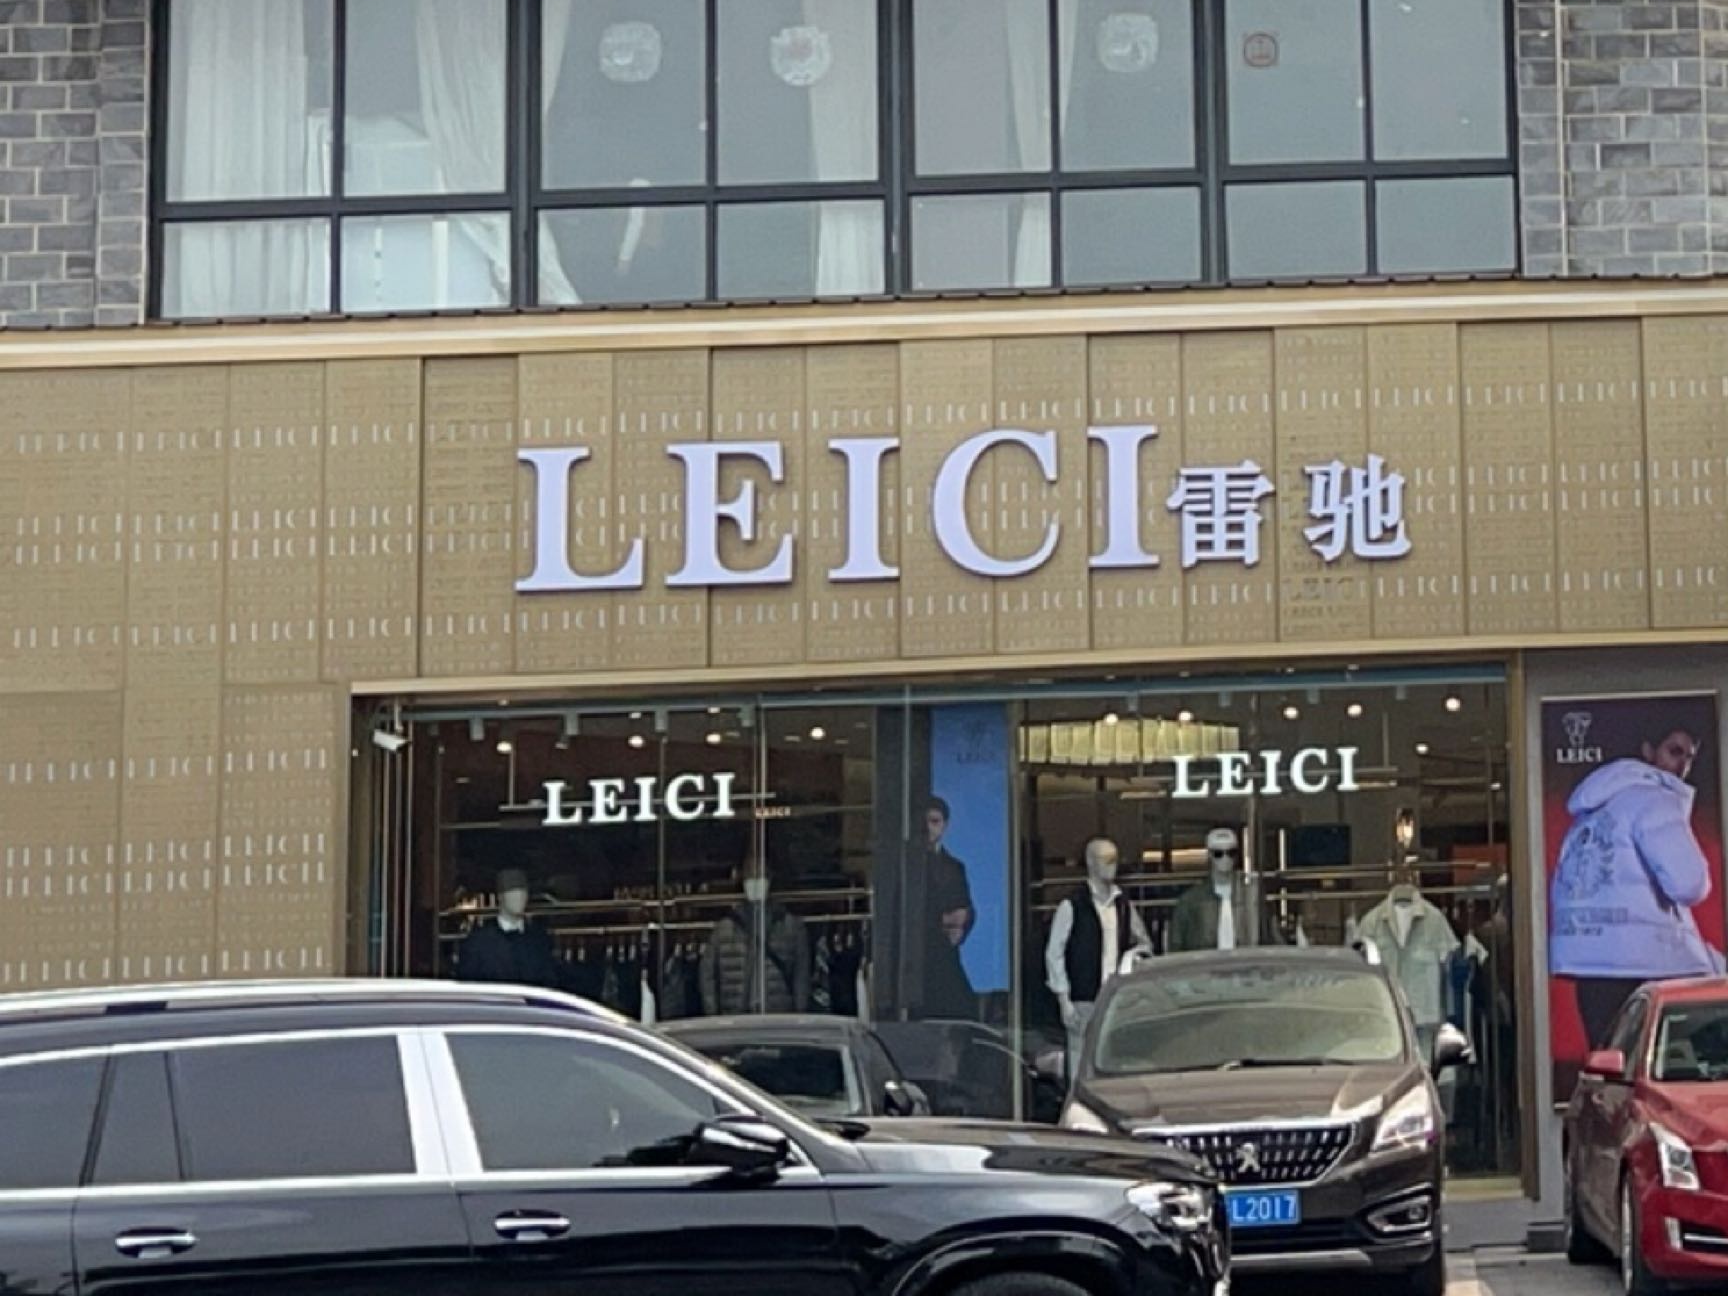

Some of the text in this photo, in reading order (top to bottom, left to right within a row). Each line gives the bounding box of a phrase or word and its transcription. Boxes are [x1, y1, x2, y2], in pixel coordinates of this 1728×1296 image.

[515, 423, 1161, 592] LEICI
[1166, 453, 1413, 568] 雷驰
[1171, 745, 1360, 799] LEICI
[1556, 747, 1602, 764] LEICI
[542, 771, 736, 827] LEICI
